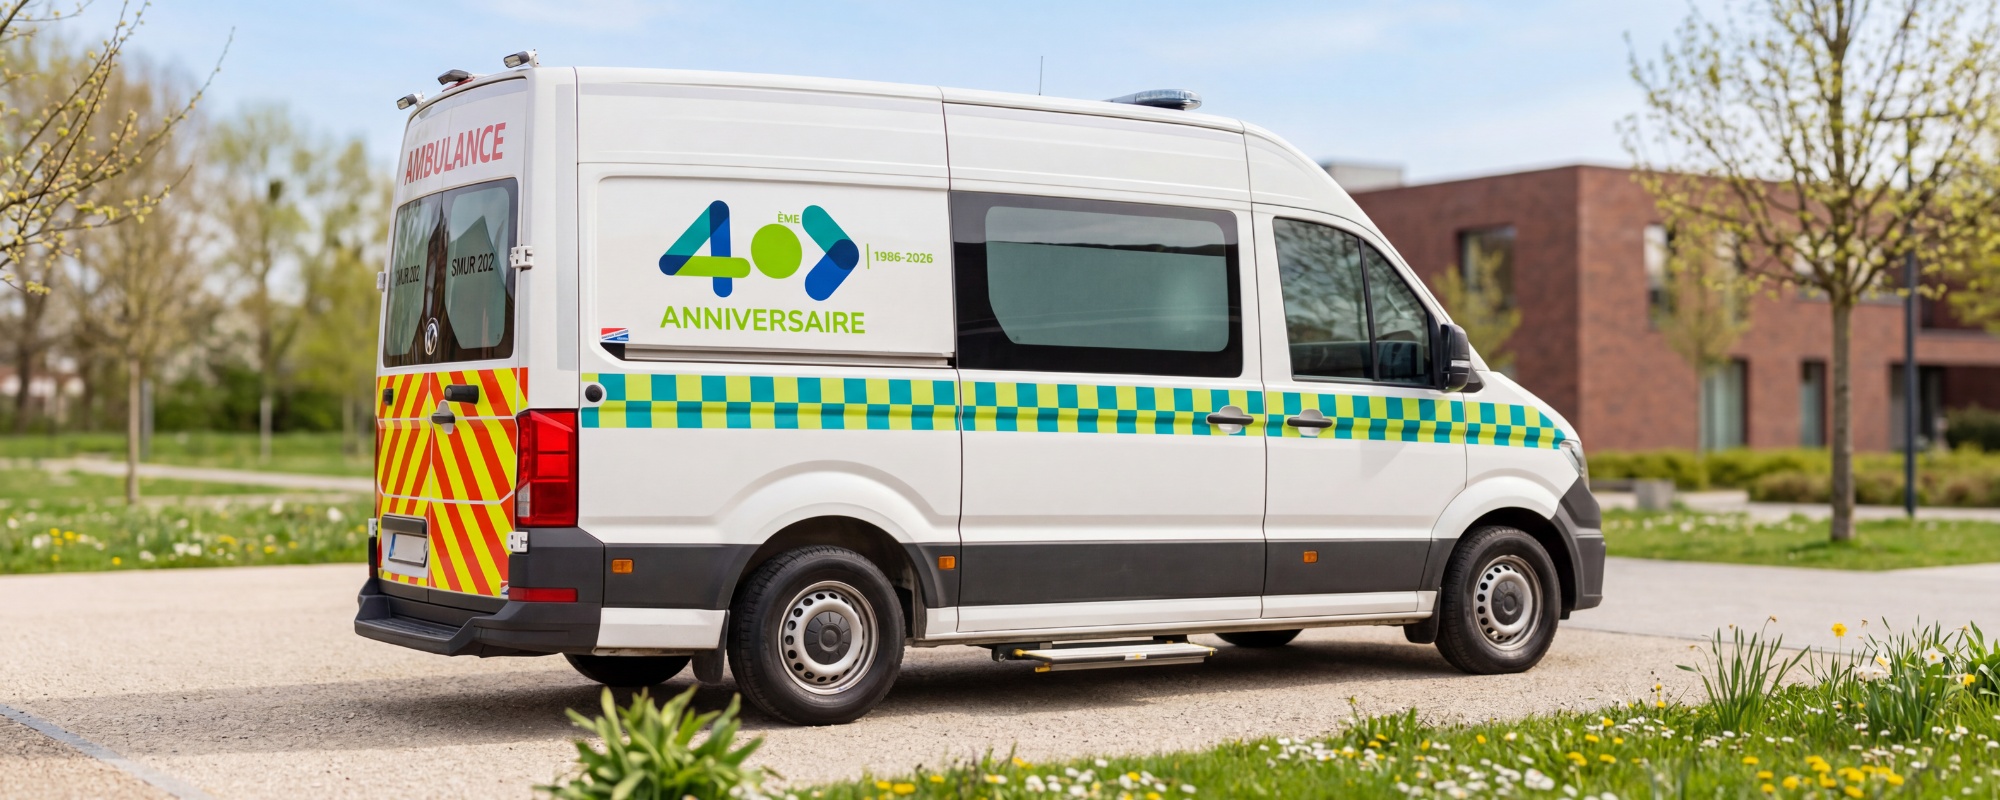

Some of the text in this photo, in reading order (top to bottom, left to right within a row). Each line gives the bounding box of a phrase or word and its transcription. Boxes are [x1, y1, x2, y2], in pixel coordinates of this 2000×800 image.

[404, 122, 506, 185] AMBULANCE
[777, 211, 800, 224] ÈME
[451, 252, 495, 277] SMUR 202
[874, 251, 934, 264] 1986-2026
[660, 305, 866, 334] ANNIVERSAIRE
